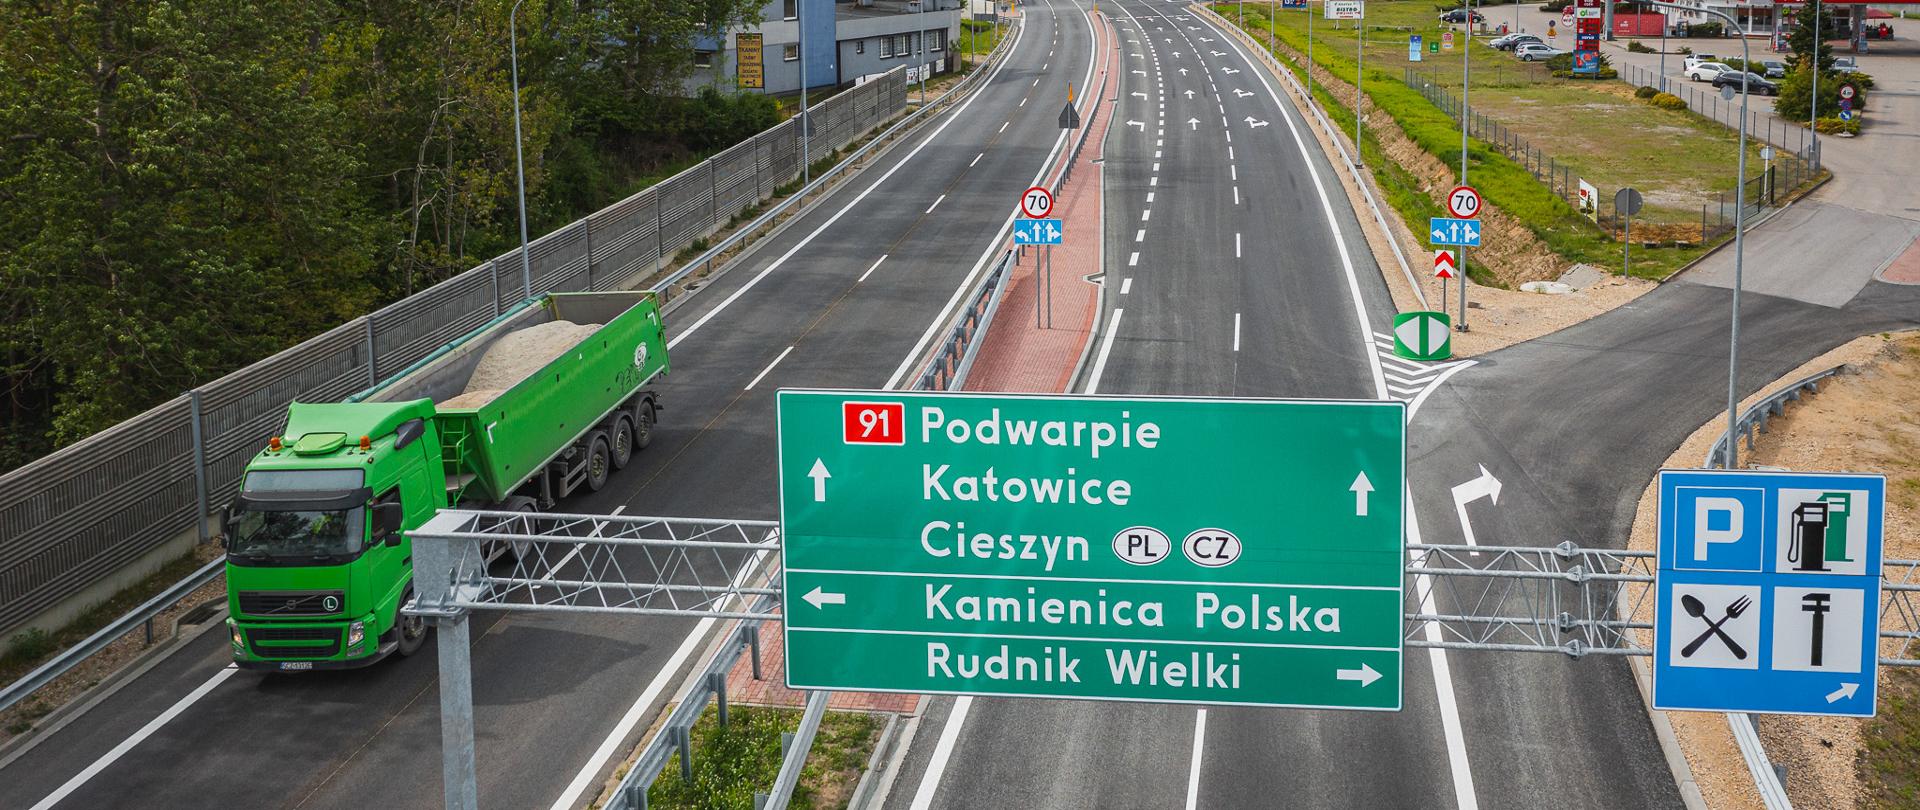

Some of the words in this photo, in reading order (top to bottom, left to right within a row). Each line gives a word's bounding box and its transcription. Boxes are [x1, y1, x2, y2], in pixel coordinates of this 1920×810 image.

[1028, 195, 1048, 210] 70
[1455, 194, 1476, 211] 70
[859, 409, 889, 438] 91
[922, 406, 1161, 458] Podwarpie
[923, 464, 1131, 506] Katowice
[921, 521, 1089, 571] Cieszyn
[1128, 534, 1157, 557] PL
[1193, 536, 1229, 560] CZ
[1694, 496, 1744, 561] P
[326, 599, 334, 609] L
[926, 583, 1164, 627] Kamienica
[1196, 592, 1341, 633] Polska
[927, 643, 1081, 683] Rudnik
[1105, 648, 1240, 689] Wielki
